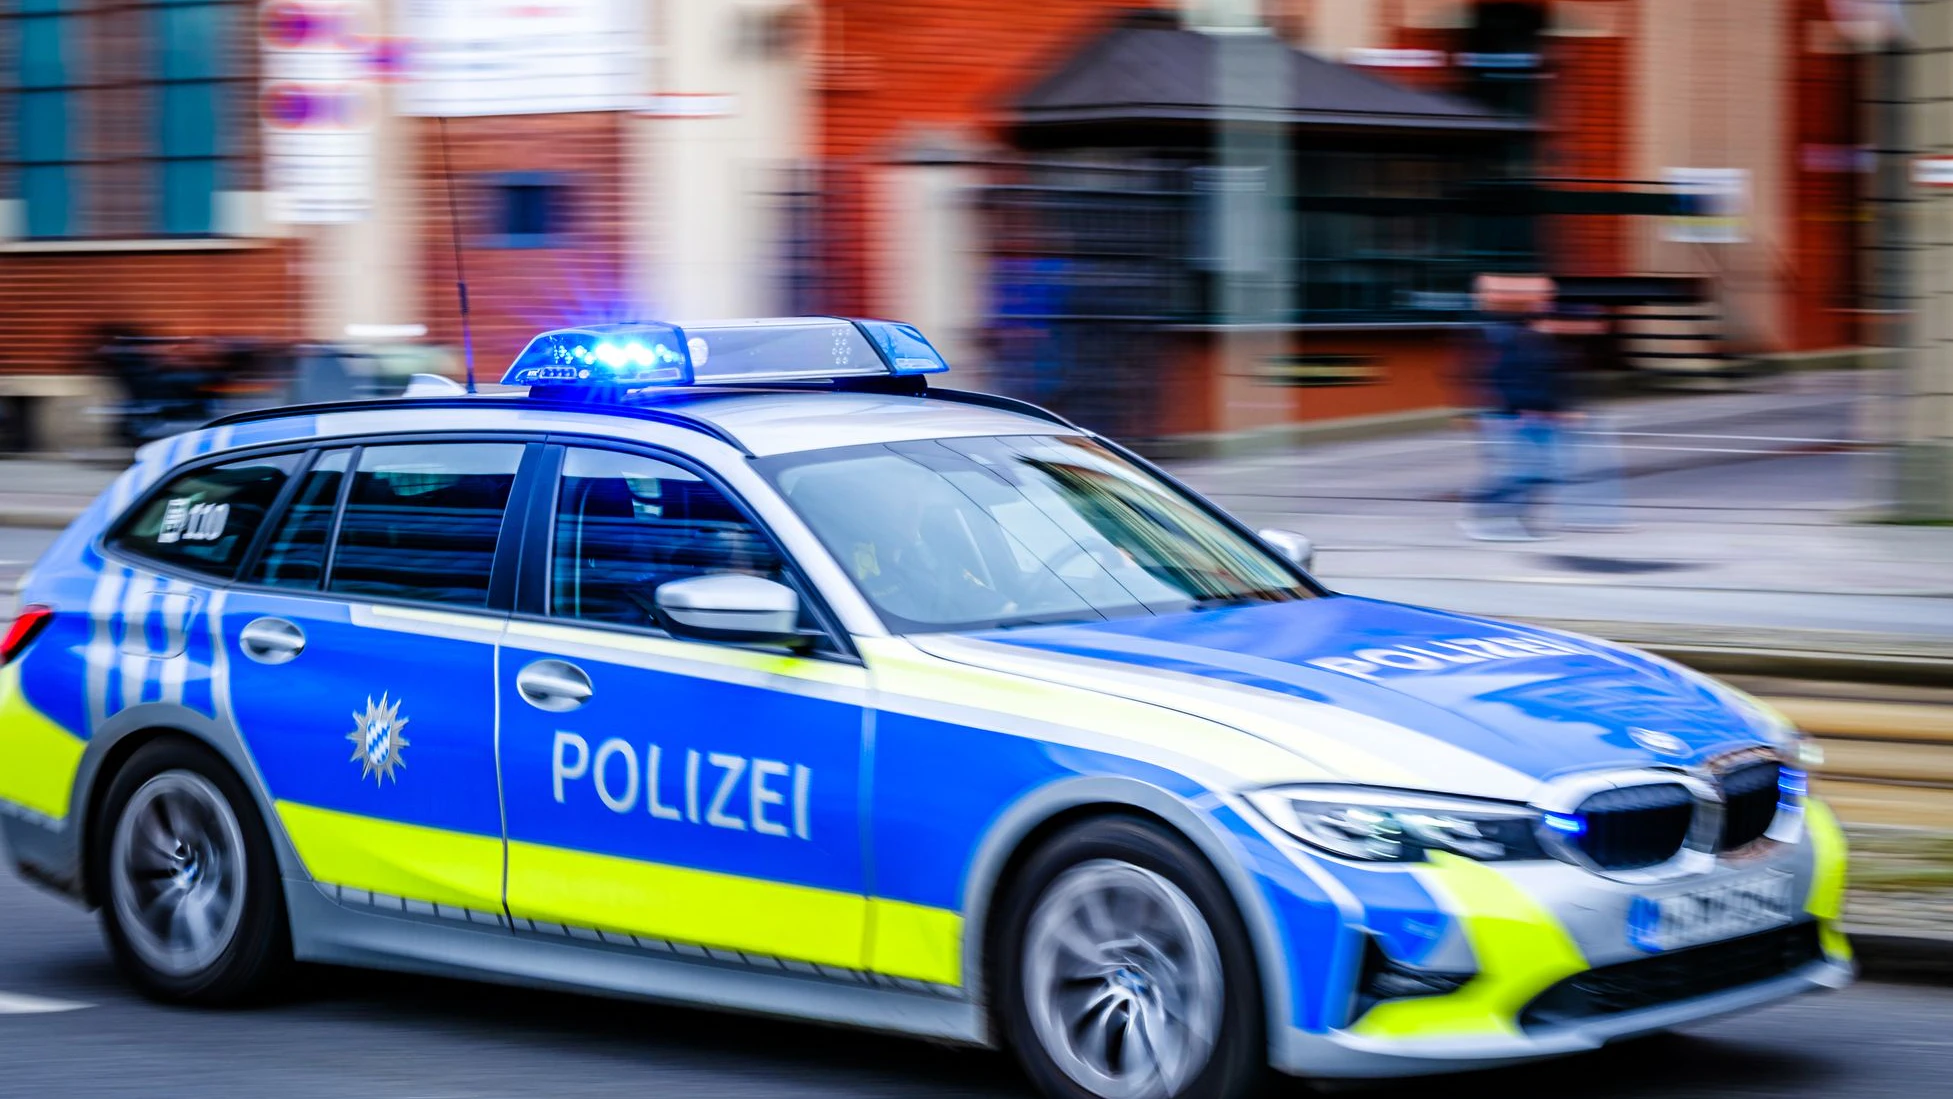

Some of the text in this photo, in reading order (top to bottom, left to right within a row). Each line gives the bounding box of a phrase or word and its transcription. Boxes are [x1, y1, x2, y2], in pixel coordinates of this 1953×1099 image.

[182, 503, 230, 540] 110
[1304, 637, 1582, 681] POLIZEI
[552, 730, 812, 840] POLIZEI
